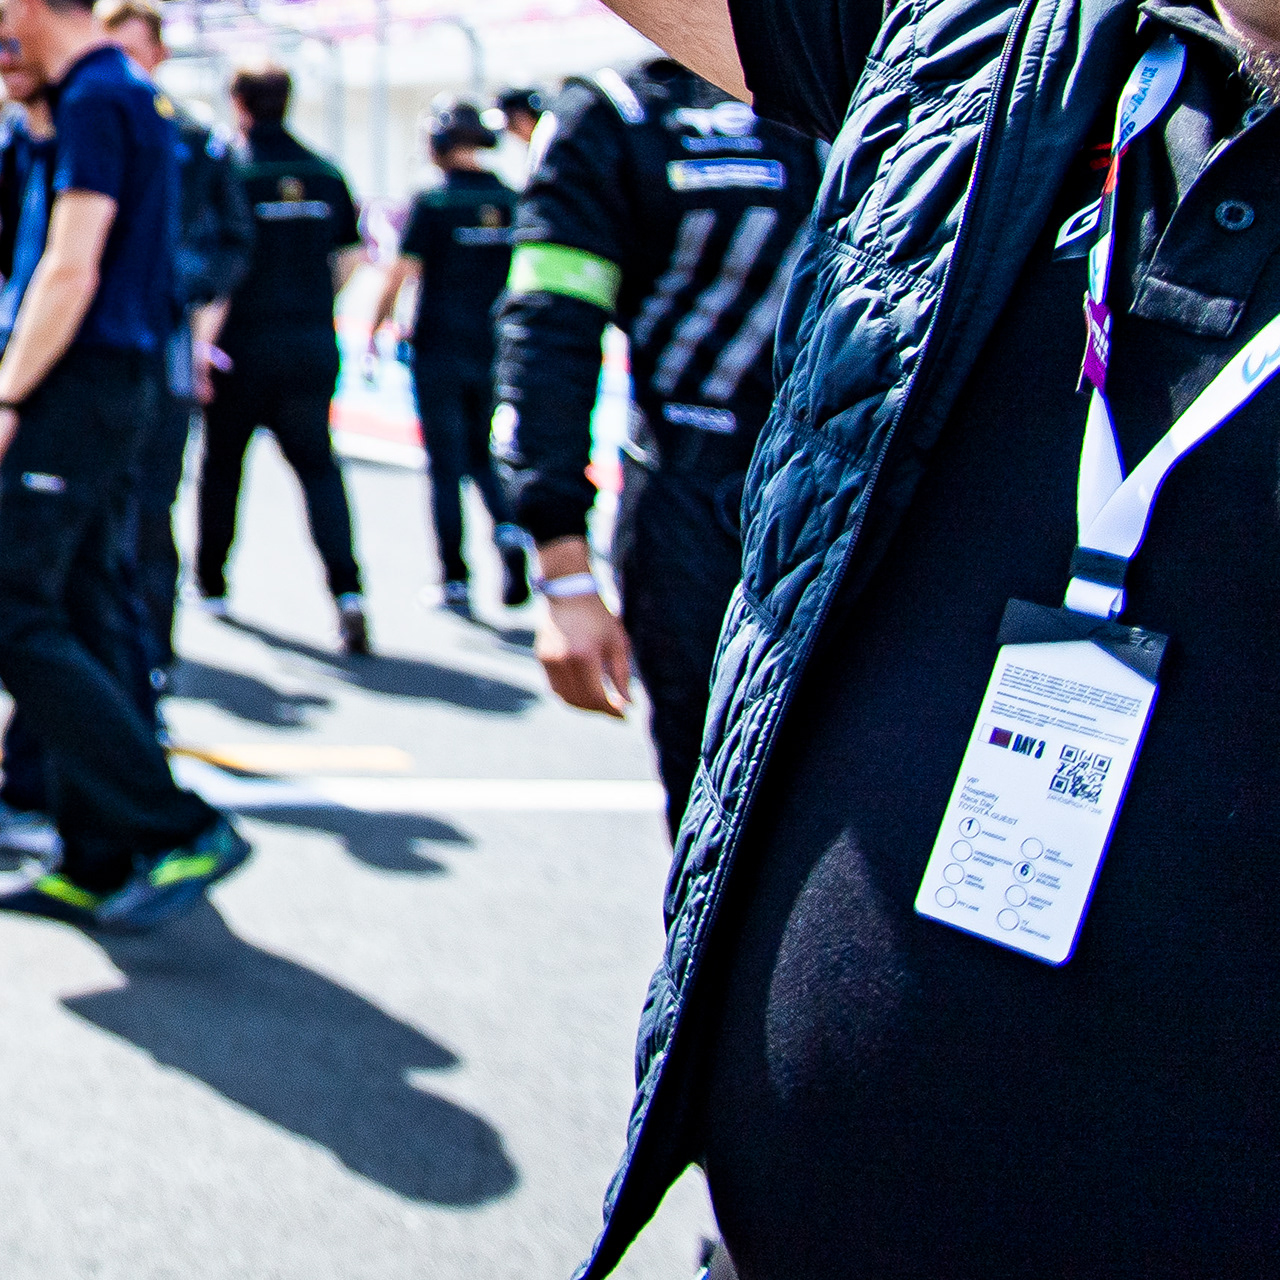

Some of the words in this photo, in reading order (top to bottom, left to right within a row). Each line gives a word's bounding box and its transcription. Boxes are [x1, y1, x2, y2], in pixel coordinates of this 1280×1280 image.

[1011, 733, 1038, 756] DAY
[966, 819, 974, 831] 1
[1020, 863, 1030, 877] 6
